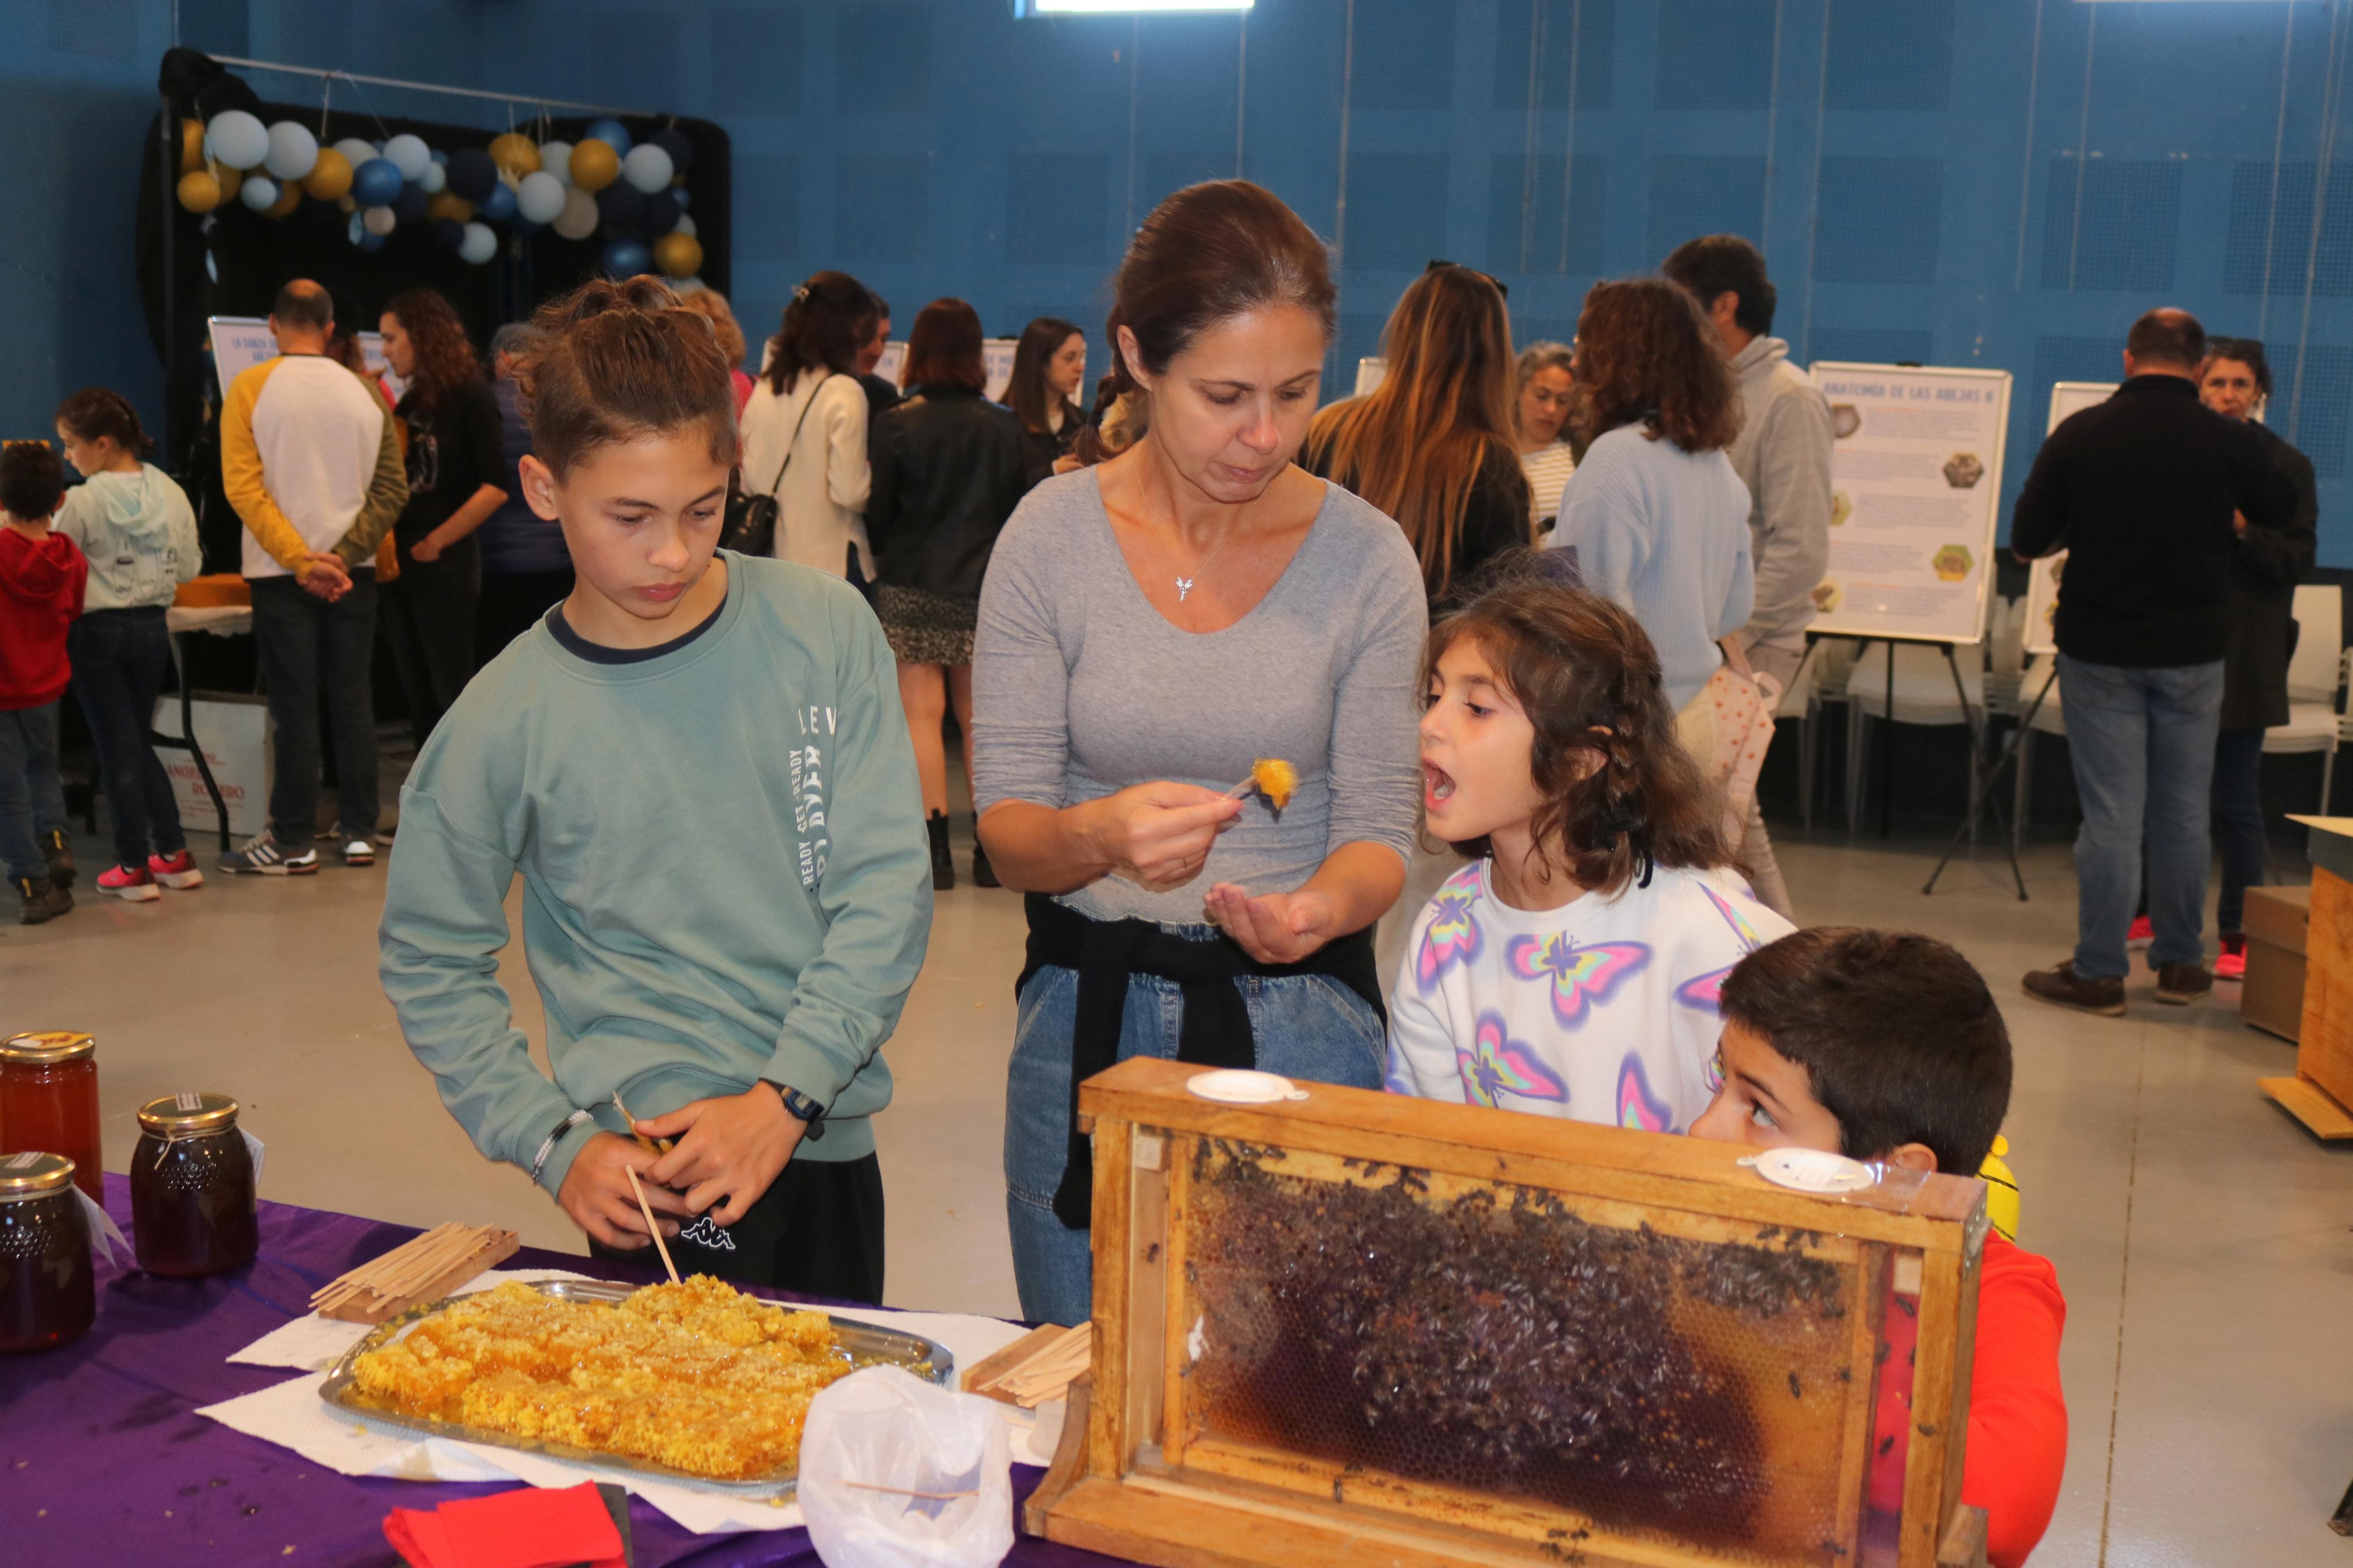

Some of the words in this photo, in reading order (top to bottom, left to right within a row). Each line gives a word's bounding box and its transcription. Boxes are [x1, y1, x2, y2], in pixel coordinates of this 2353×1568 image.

[1890, 385, 1904, 399] DE
[1910, 386, 1930, 400] LAS
[1936, 387, 1981, 403] ABEJAS
[192, 783, 244, 799] ROERO
[798, 841, 814, 886] READY
